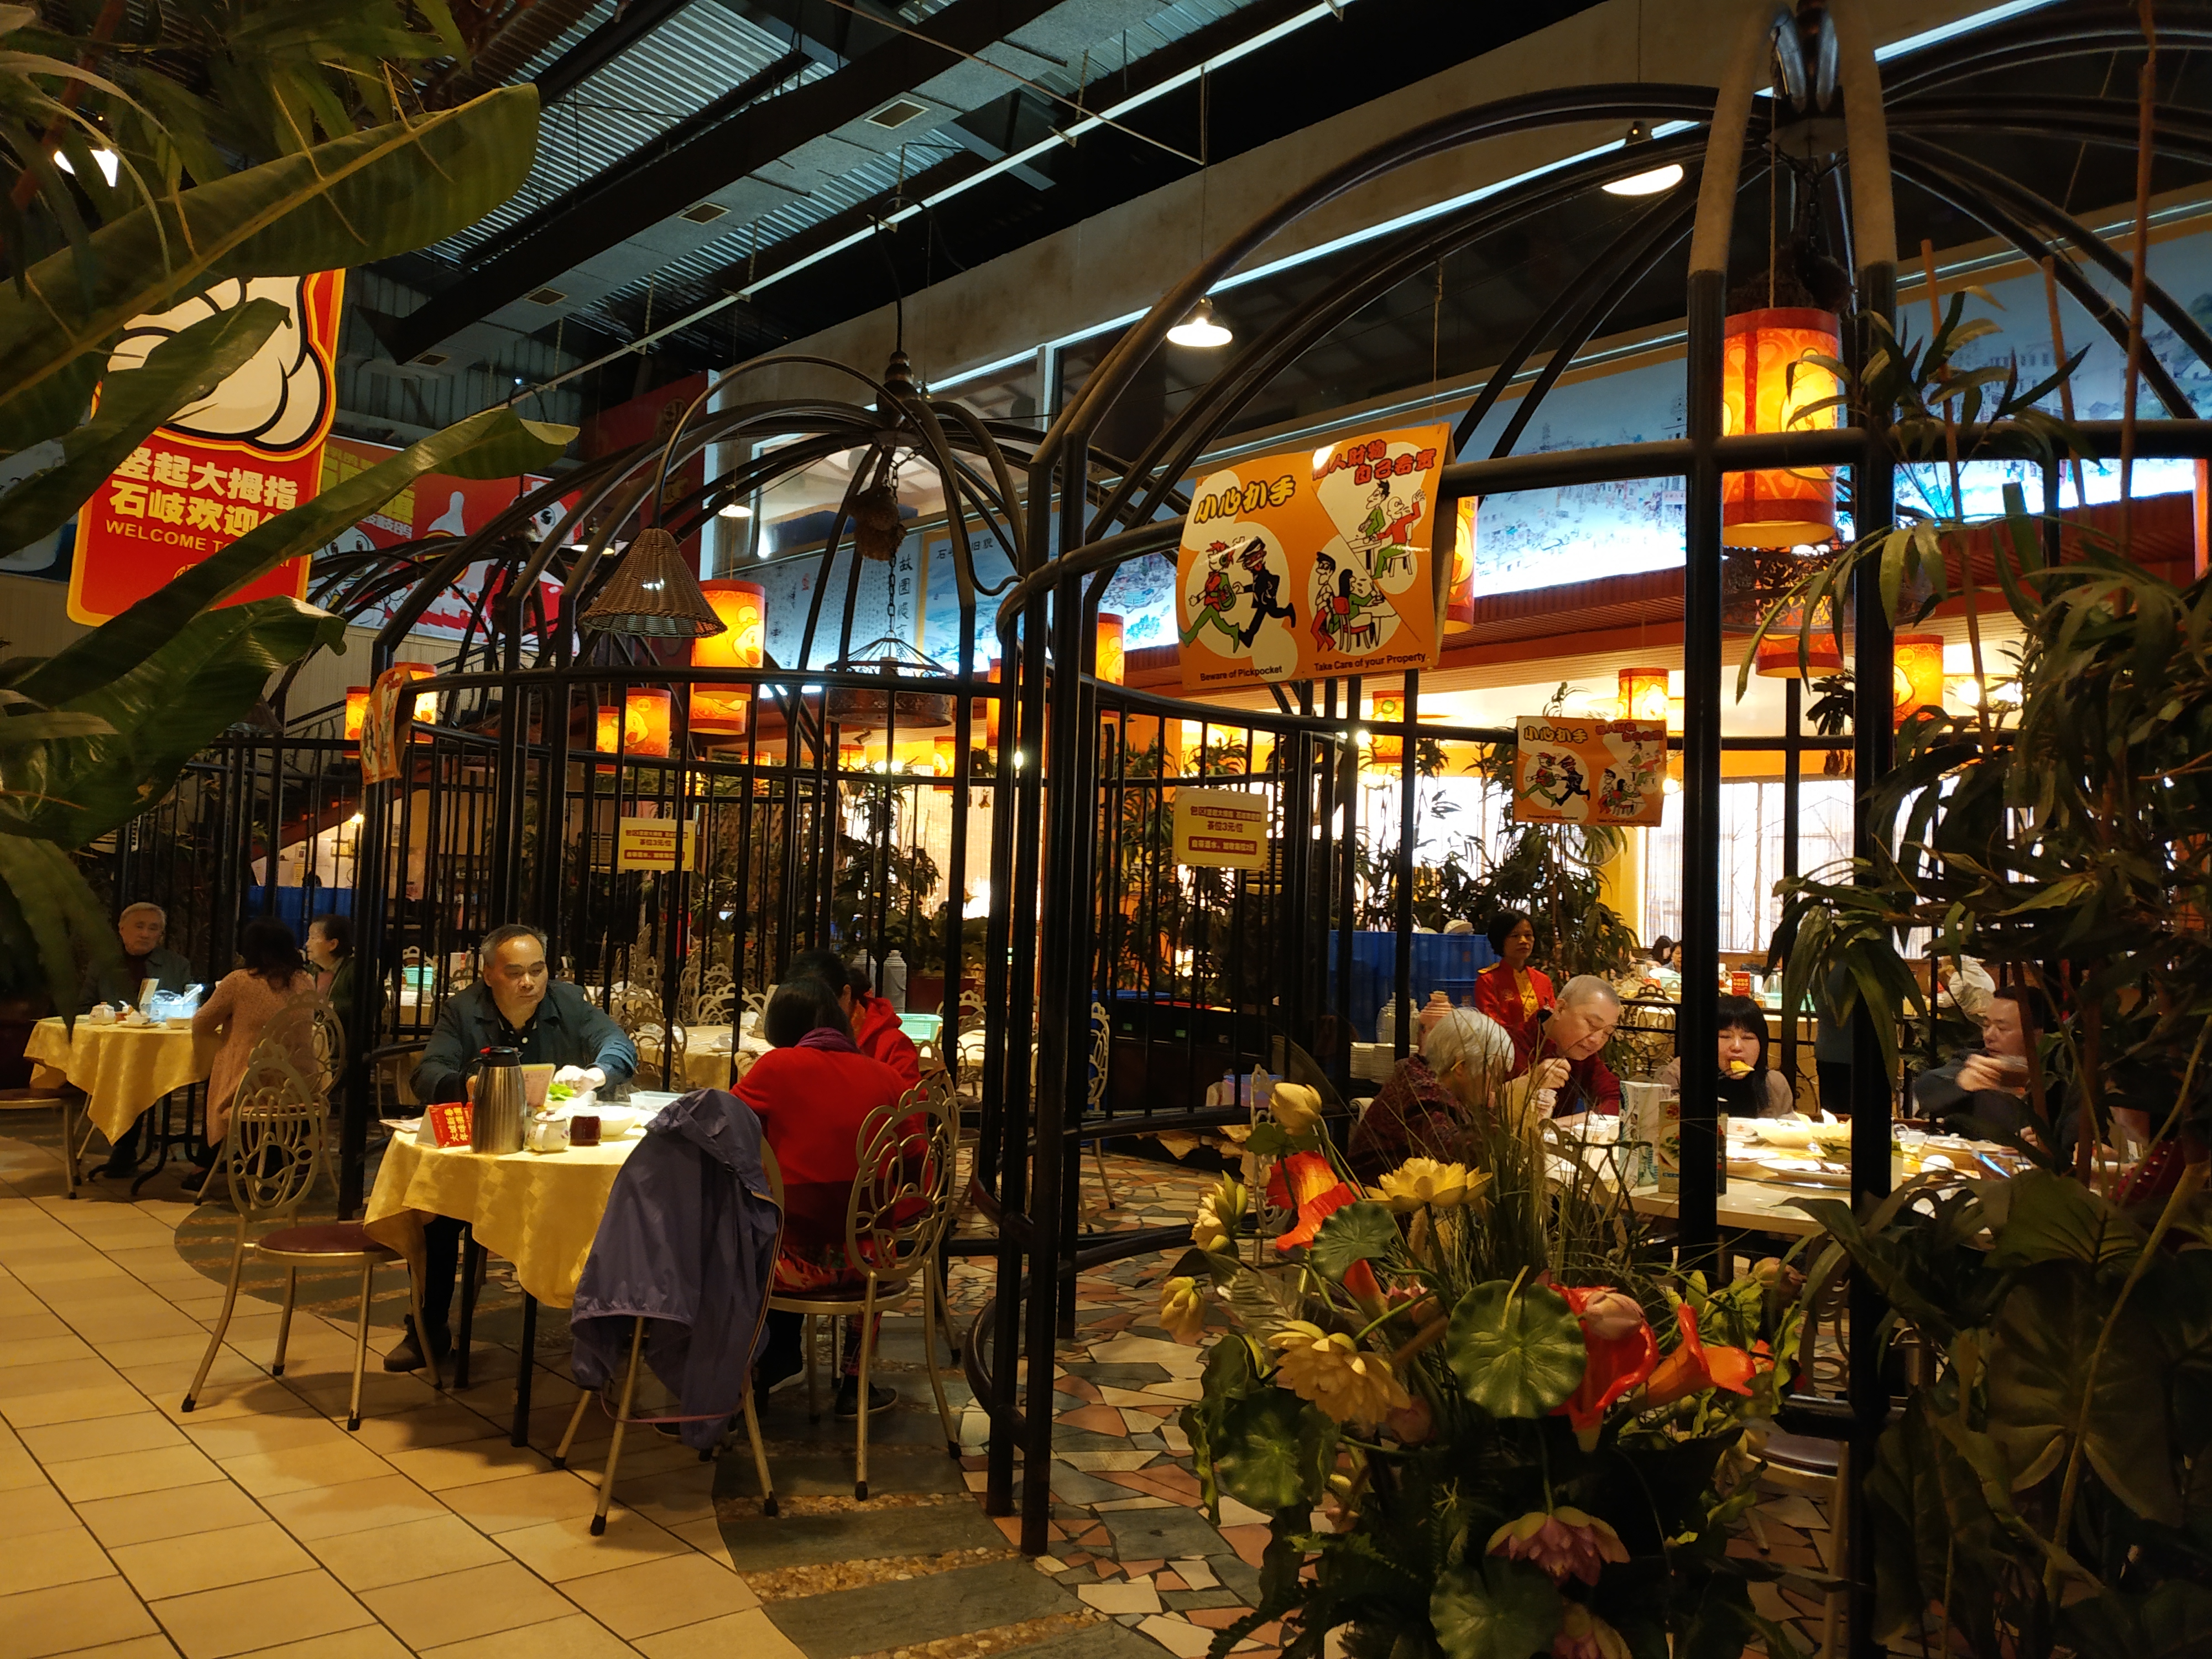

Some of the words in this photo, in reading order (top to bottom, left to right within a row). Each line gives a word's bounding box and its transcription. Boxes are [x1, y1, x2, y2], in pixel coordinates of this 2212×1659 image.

[112, 446, 299, 511] 竖起大拇指
[1193, 474, 1297, 524] 小心扒手
[106, 519, 207, 551] WELCOME
[1200, 671, 1227, 682] Beware
[1228, 669, 1237, 679] of
[1237, 665, 1283, 679] Pickpocket
[1314, 662, 1333, 672] Take
[1334, 660, 1354, 670] Care
[1355, 659, 1364, 667] of
[1364, 658, 1385, 669] your
[1386, 652, 1426, 665] Property
[1523, 725, 1588, 744] 小心扒手
